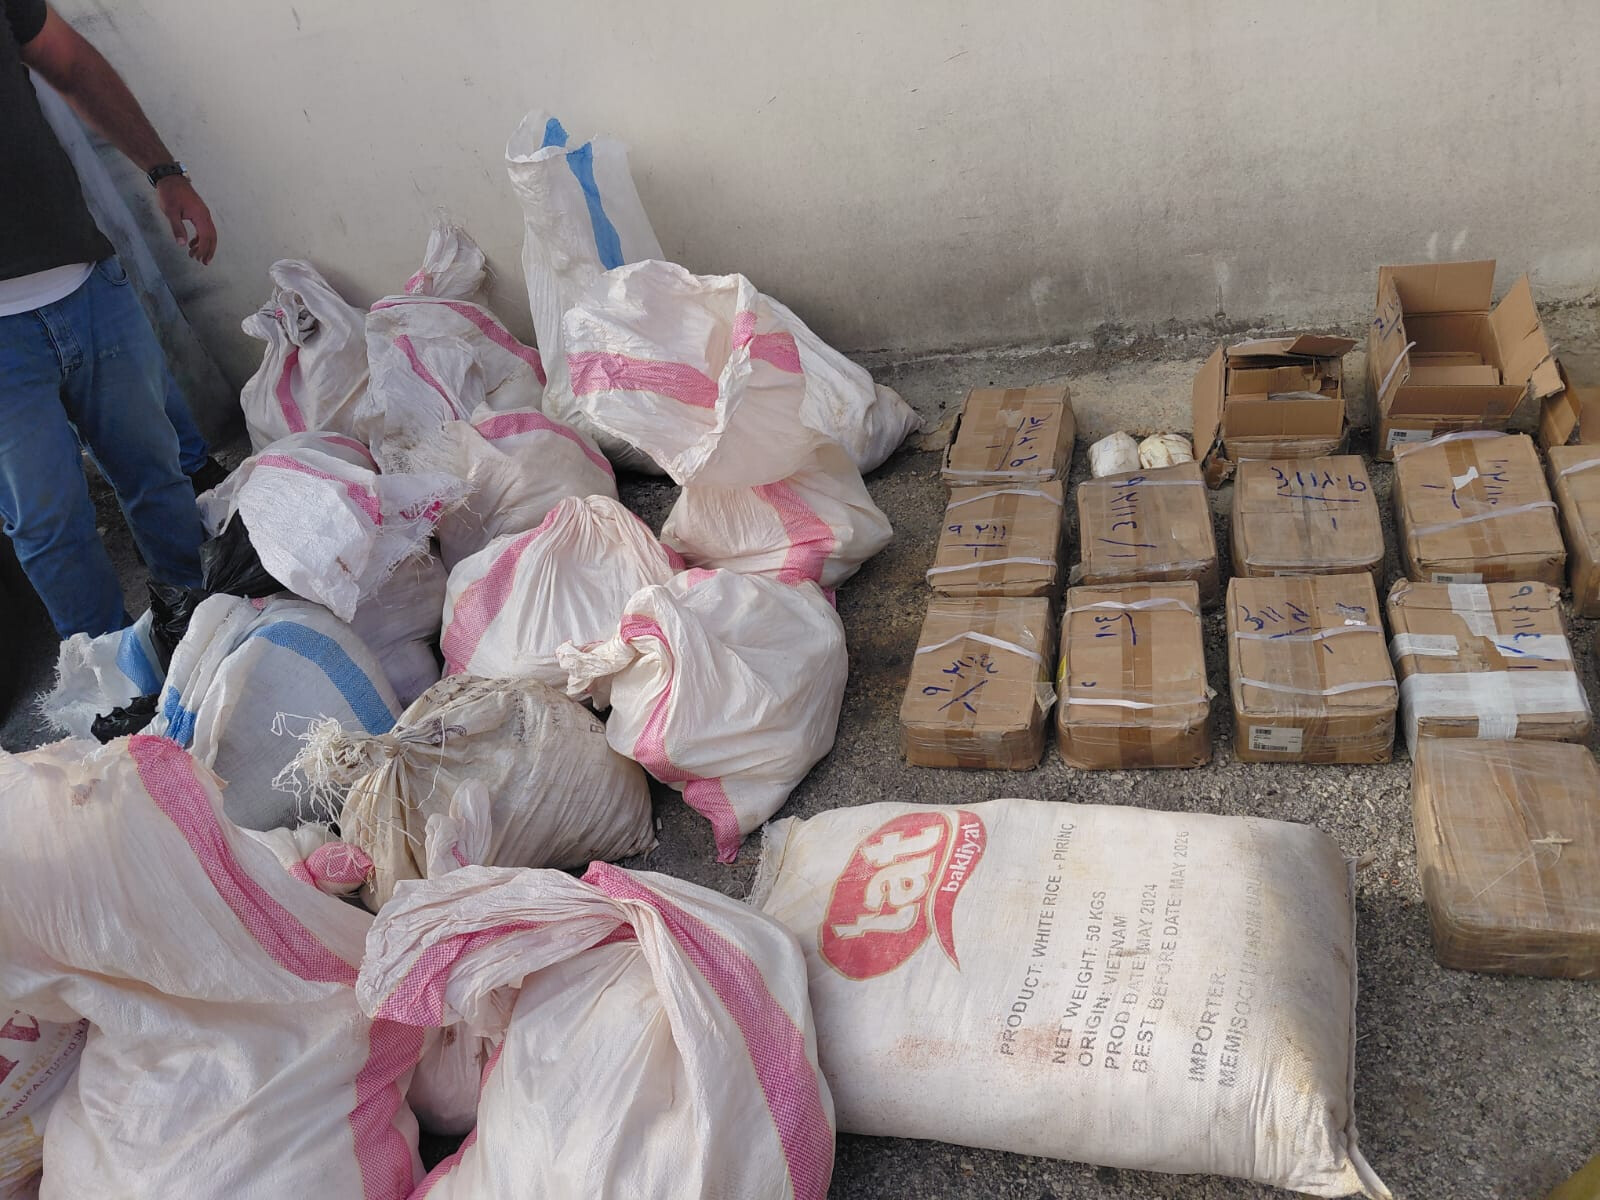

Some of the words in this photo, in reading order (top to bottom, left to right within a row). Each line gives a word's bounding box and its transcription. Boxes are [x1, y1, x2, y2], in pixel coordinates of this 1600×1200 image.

[940, 822, 982, 893] bakliyat
[1173, 829, 1191, 858] 2026
[1042, 874, 1063, 906] RICE
[1168, 860, 1186, 888] MAY
[1089, 889, 1106, 920] KGS
[1141, 883, 1158, 914] 2024
[1032, 909, 1055, 957] WHITE
[1086, 924, 1102, 942] 50
[1134, 917, 1153, 953] MAY
[1062, 946, 1098, 1018] WEIGHT:
[1078, 991, 1112, 1067] ORIGIN:
[1103, 913, 1127, 986] VIETNAM
[1147, 940, 1177, 1012] BEFORE
[1000, 964, 1045, 1056] PRODUCT:
[1052, 1023, 1072, 1065] NET
[1131, 1015, 1156, 1073] BEST
